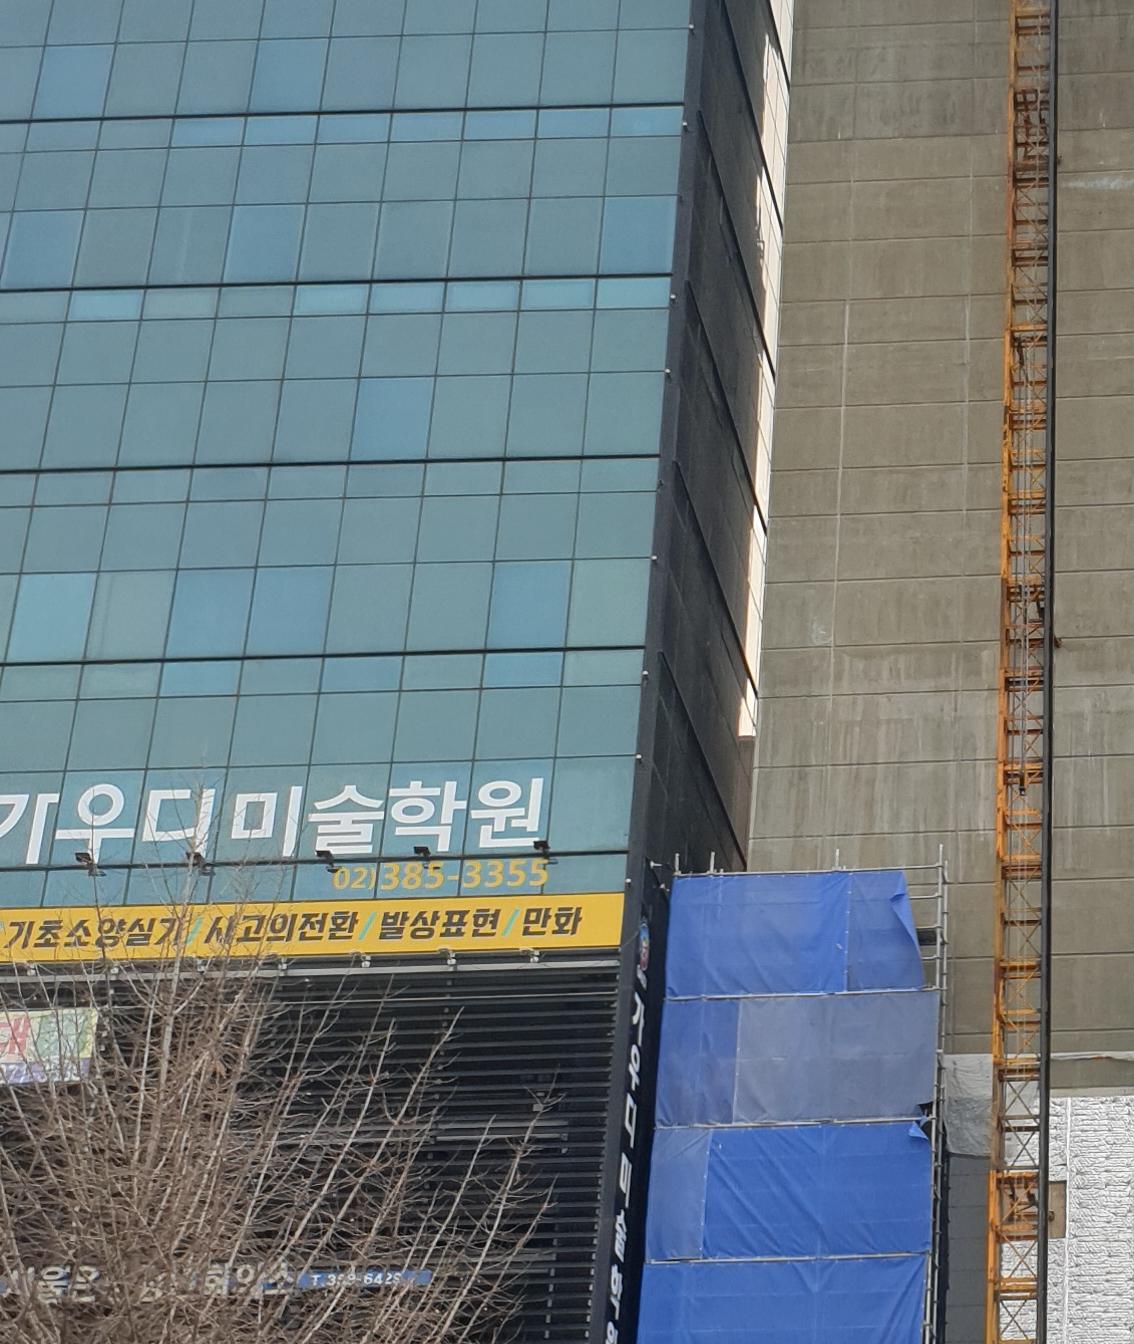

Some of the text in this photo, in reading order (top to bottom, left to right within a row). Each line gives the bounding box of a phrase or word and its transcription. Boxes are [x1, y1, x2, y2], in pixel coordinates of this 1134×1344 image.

[0, 778, 545, 864] 가우디미술학원
[378, 908, 501, 940] 발상표현
[522, 906, 582, 937] 만화
